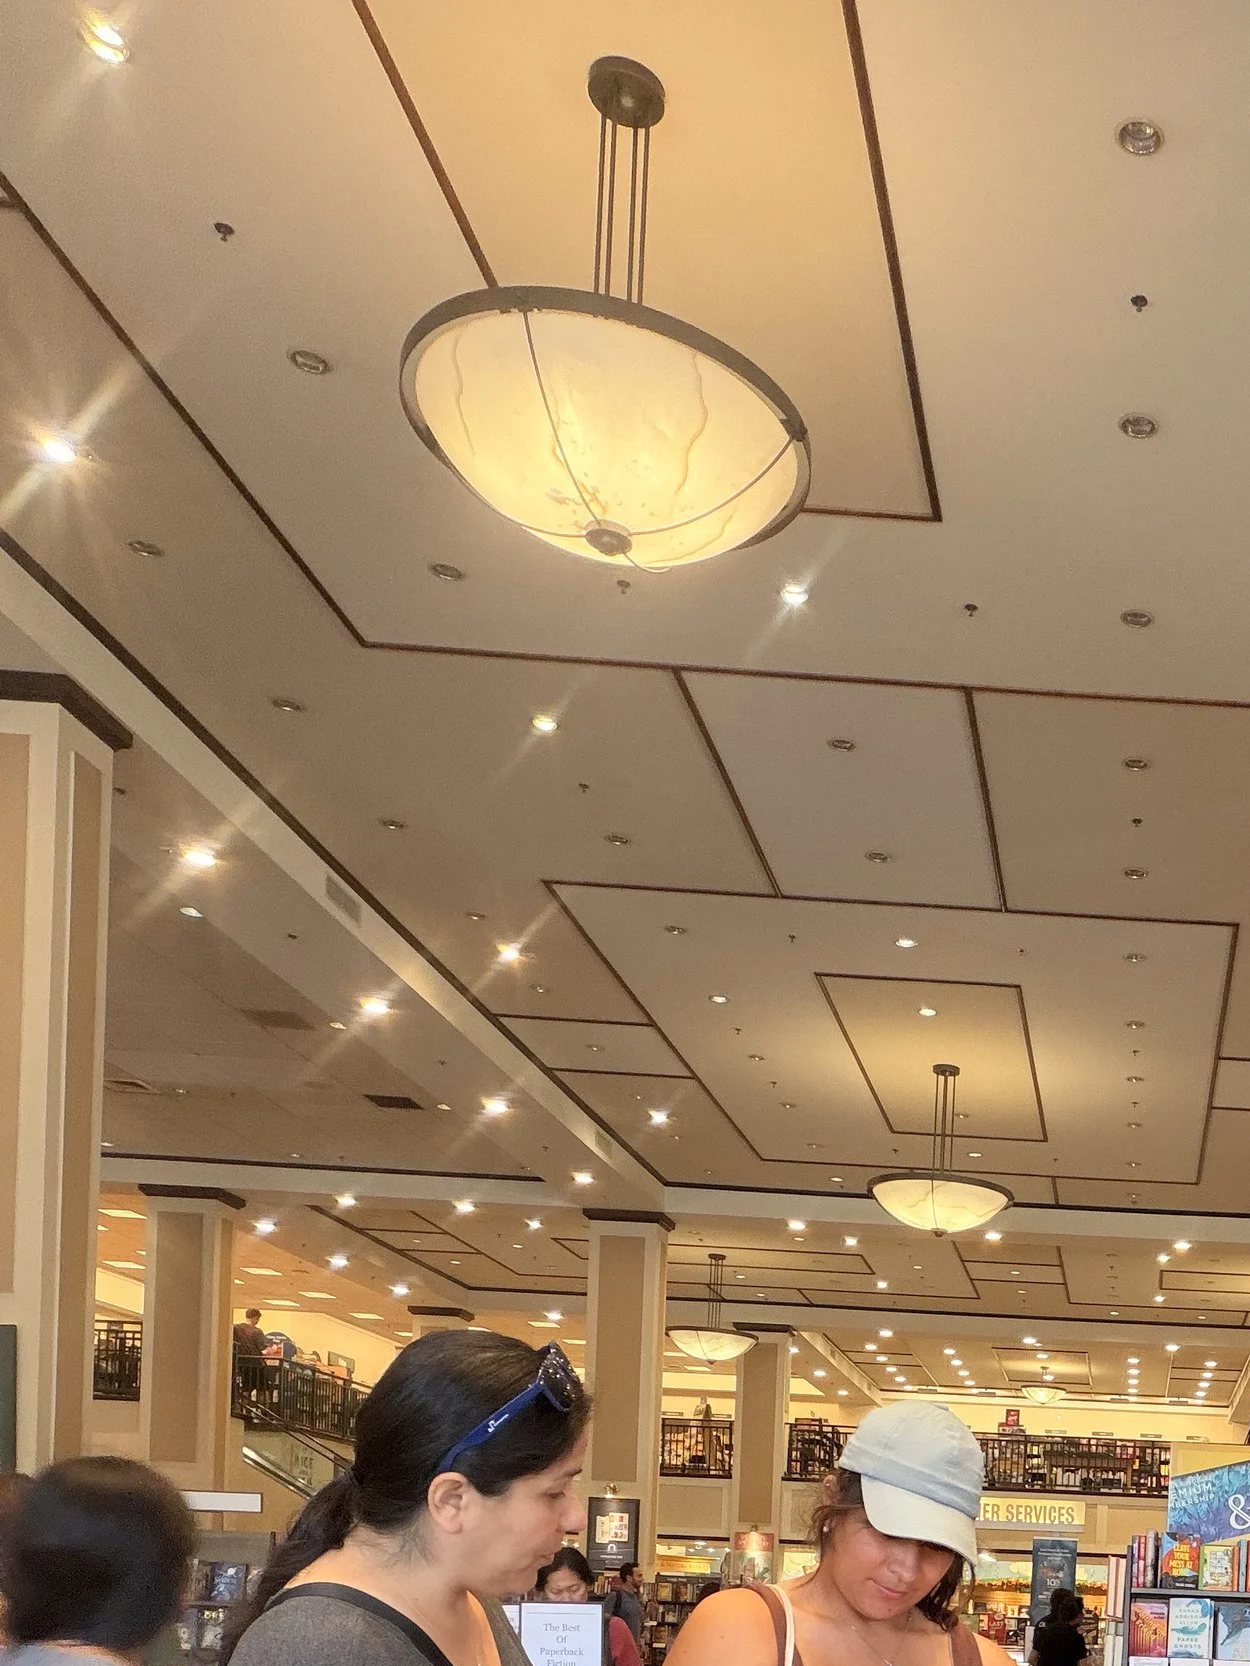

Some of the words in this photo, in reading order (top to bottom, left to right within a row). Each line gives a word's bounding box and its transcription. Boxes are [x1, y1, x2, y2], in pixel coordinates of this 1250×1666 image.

[1005, 1503, 1075, 1524] SERVICES
[543, 1623, 560, 1632] The
[562, 1624, 581, 1632] Best
[556, 1635, 568, 1644] Of
[539, 1647, 584, 1657] Paperback
